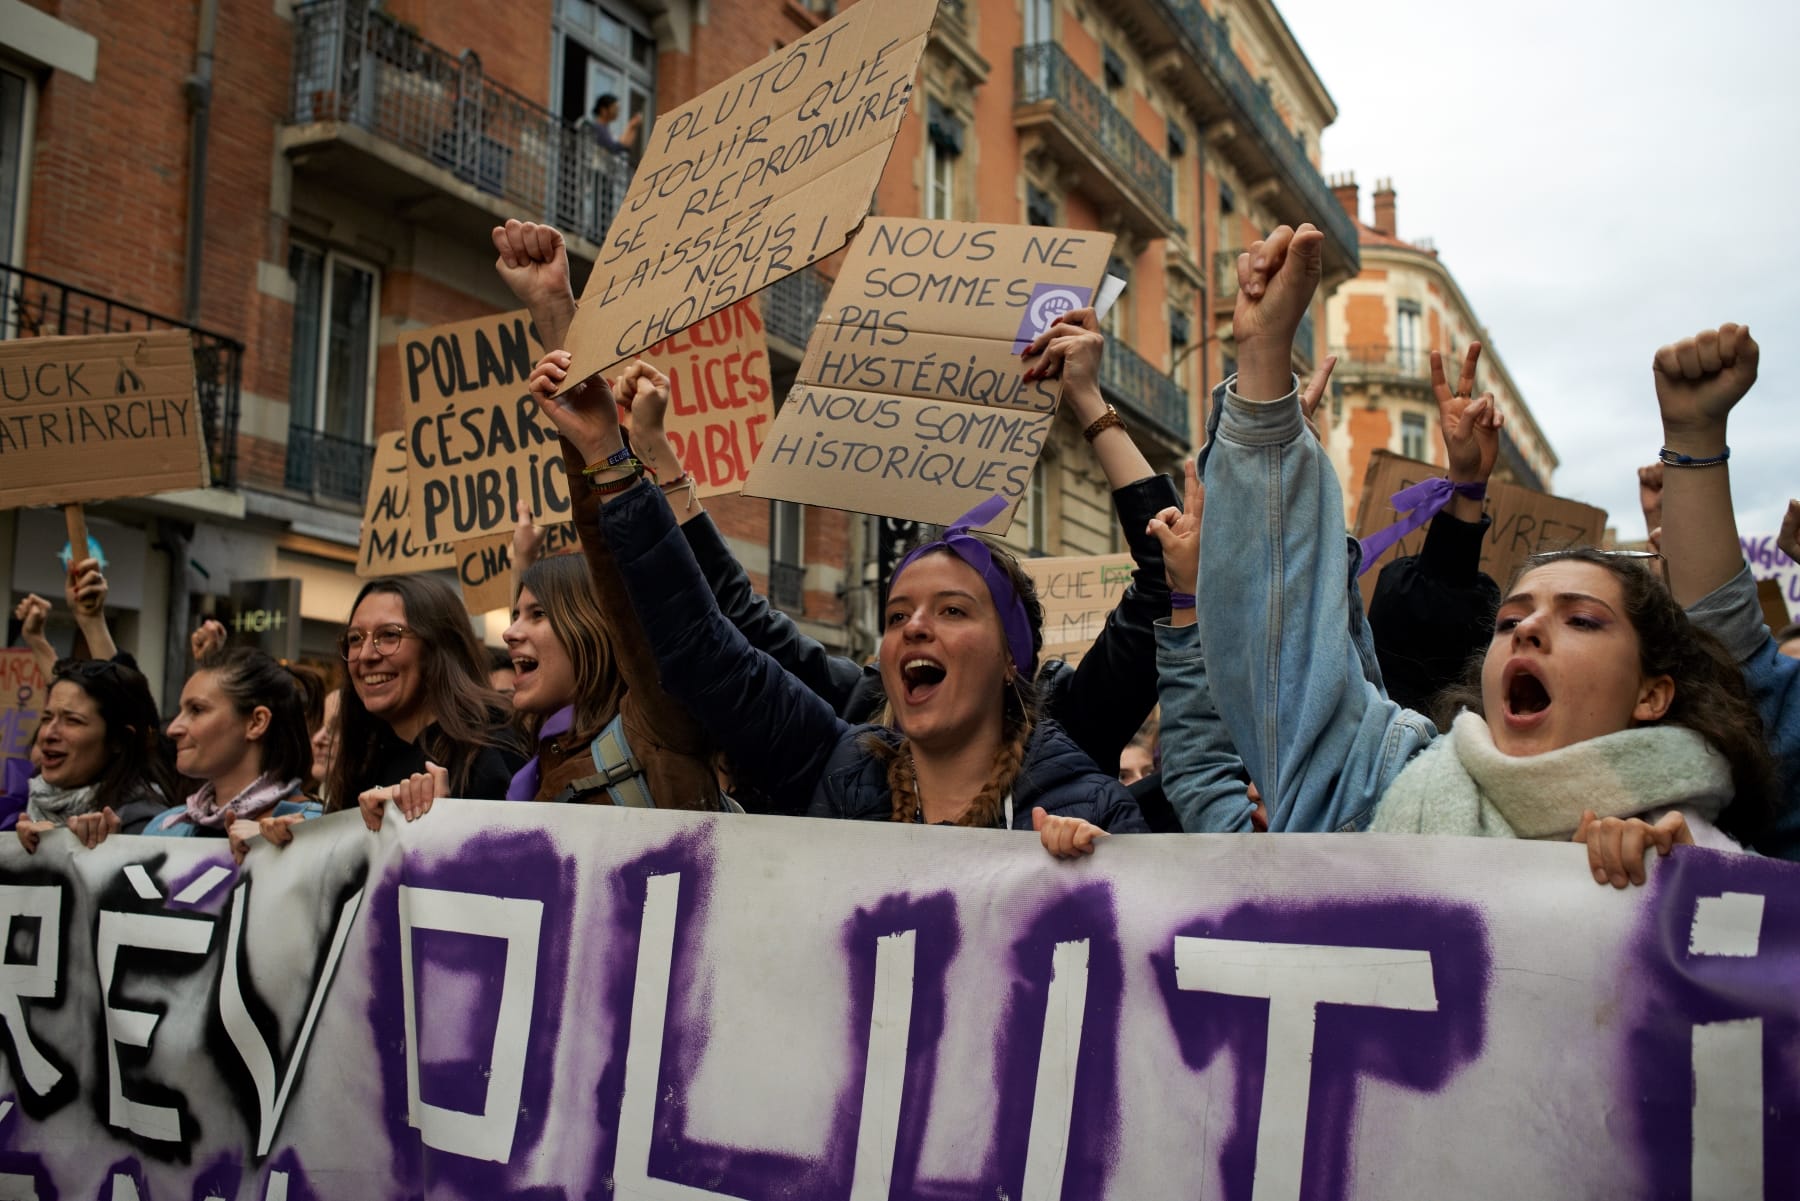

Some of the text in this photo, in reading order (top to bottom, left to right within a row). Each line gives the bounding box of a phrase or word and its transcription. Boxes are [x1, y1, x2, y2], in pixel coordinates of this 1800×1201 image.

[664, 22, 849, 153] PLUTÔT
[631, 38, 899, 212] JOUIR QUE
[600, 194, 774, 308] LAISSEZ
[604, 214, 658, 264] SE
[684, 213, 797, 292] NOUS
[868, 225, 1086, 269] NOUS NE
[863, 268, 1033, 308] SOMMES
[833, 305, 909, 346] PAS
[797, 391, 1043, 458] NOUS SOMMES
[771, 431, 1029, 497] HISTORIQUES
